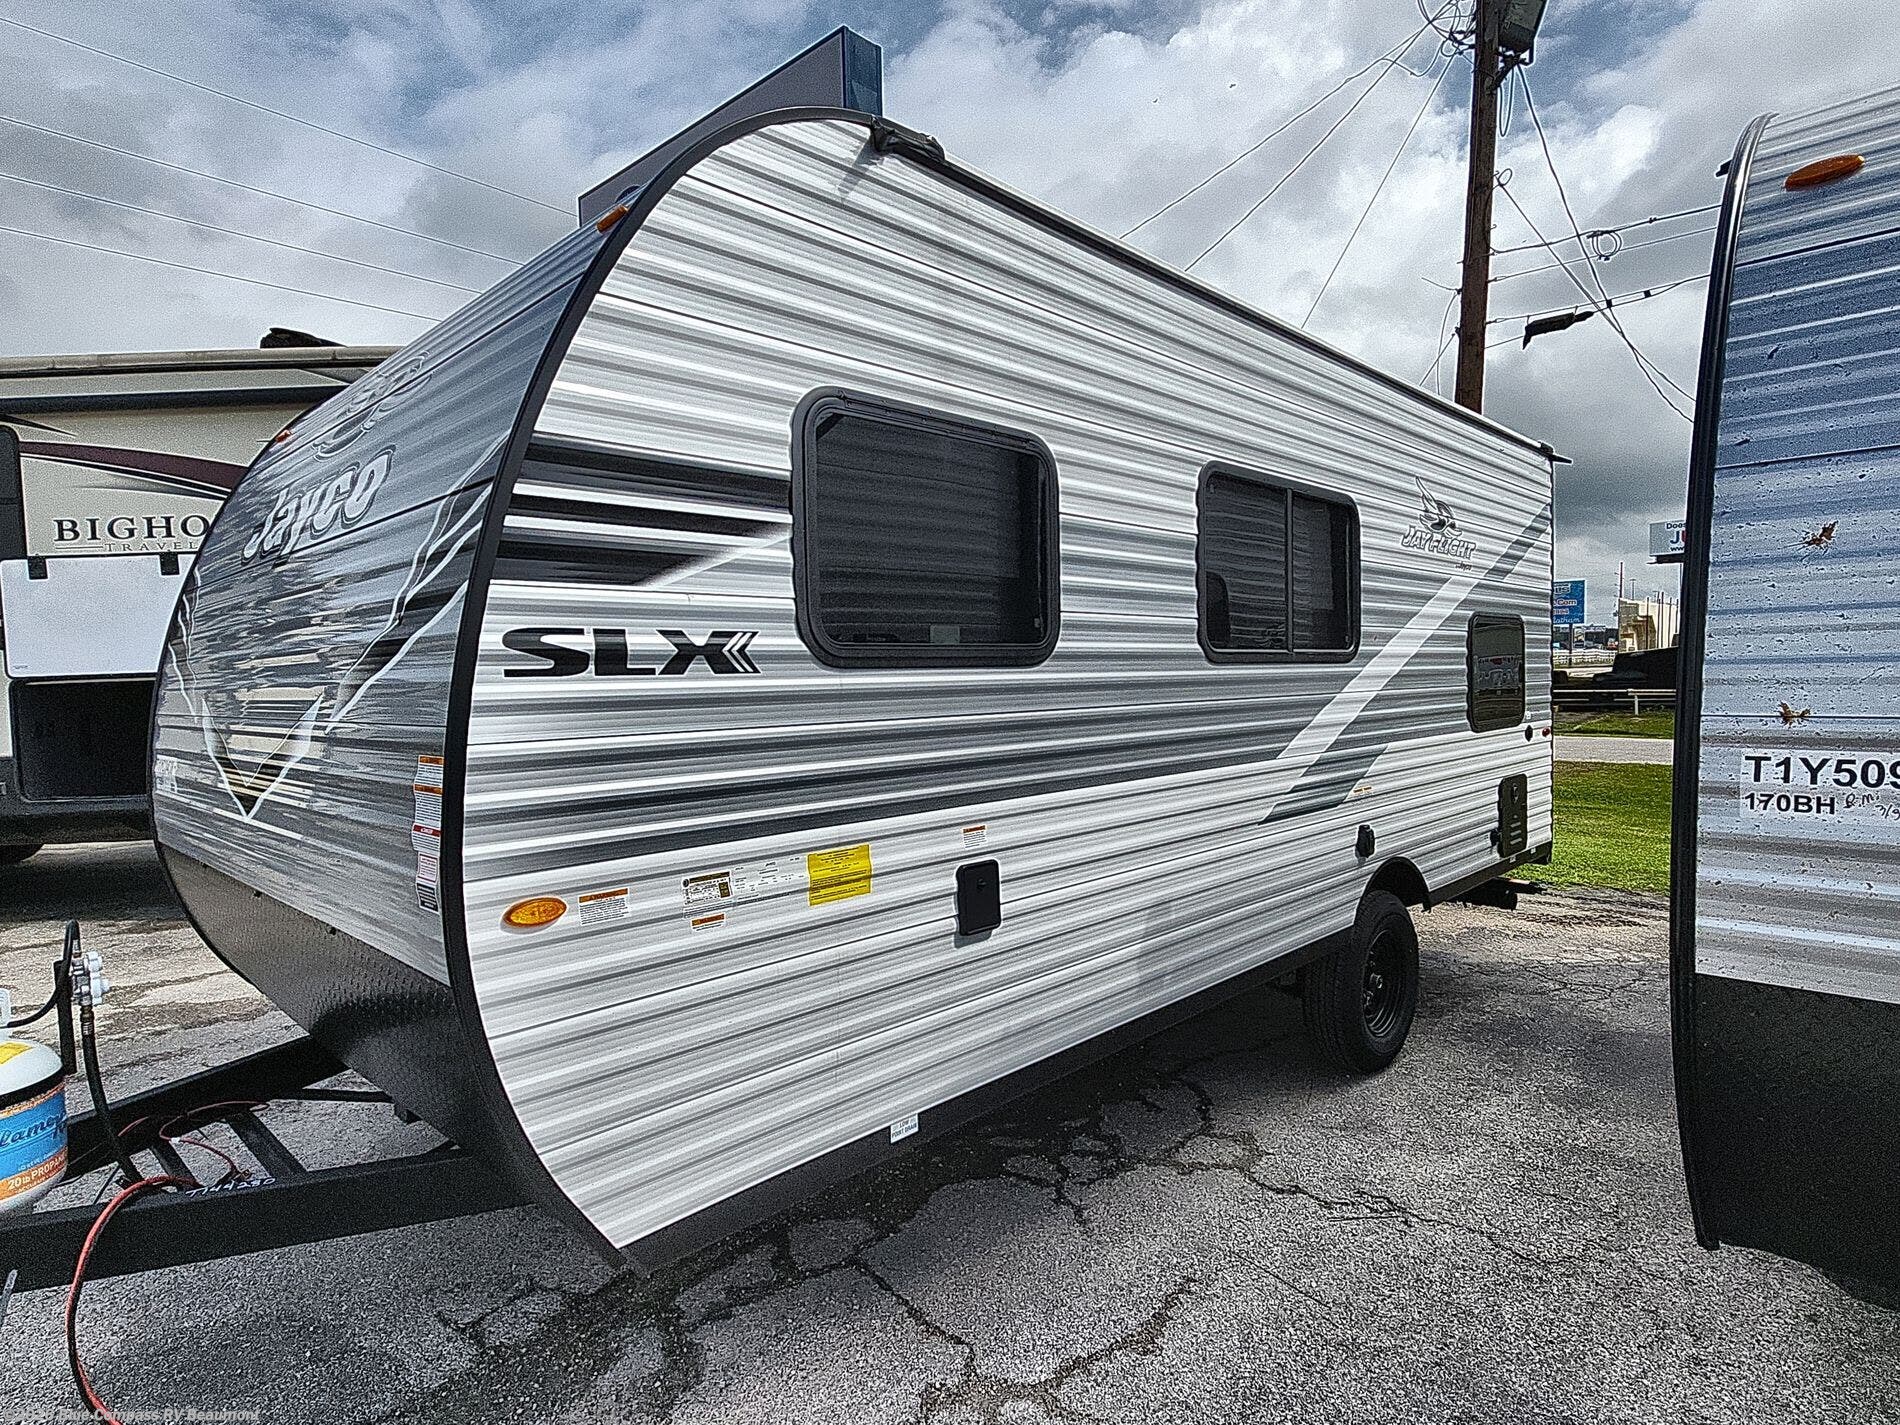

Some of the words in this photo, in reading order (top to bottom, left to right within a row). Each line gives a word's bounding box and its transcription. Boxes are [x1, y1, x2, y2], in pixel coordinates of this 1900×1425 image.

[53, 515, 210, 541] BIGHO
[1401, 524, 1432, 549] JAY
[501, 627, 762, 678] SLX
[1744, 792, 1835, 815] 170BH
[0, 1115, 57, 1147] lame
[7, 1176, 21, 1190] 20
